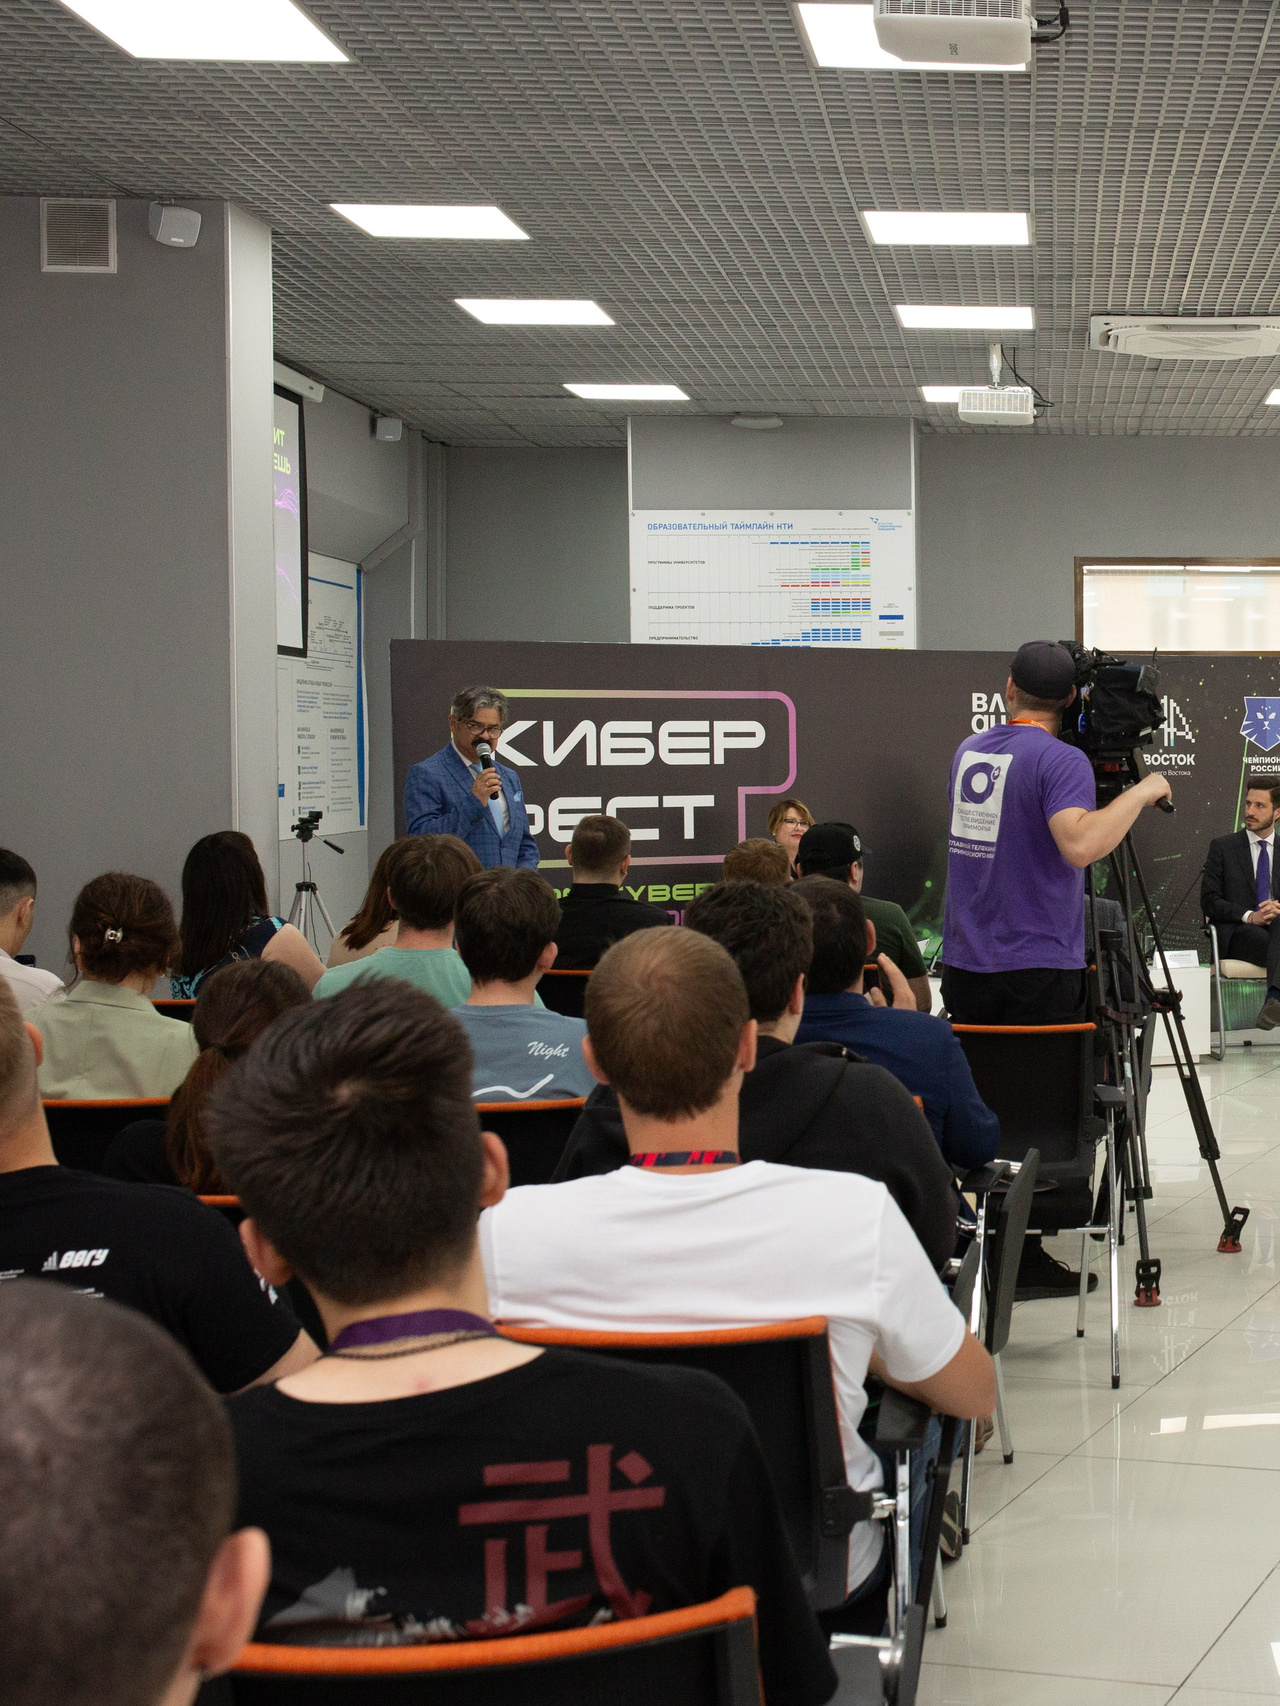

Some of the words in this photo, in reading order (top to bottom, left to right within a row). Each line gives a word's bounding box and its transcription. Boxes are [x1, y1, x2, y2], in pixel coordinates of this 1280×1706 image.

[274, 452, 291, 475] ЕШЬ
[647, 521, 728, 530] ОБРАЗОВАТЕЛЬНЫЙ
[730, 521, 774, 530] ТАЙМЛАЙН
[494, 720, 766, 767] КИБЕР
[527, 1041, 570, 1060] Night
[458, 1443, 666, 1637] 武
